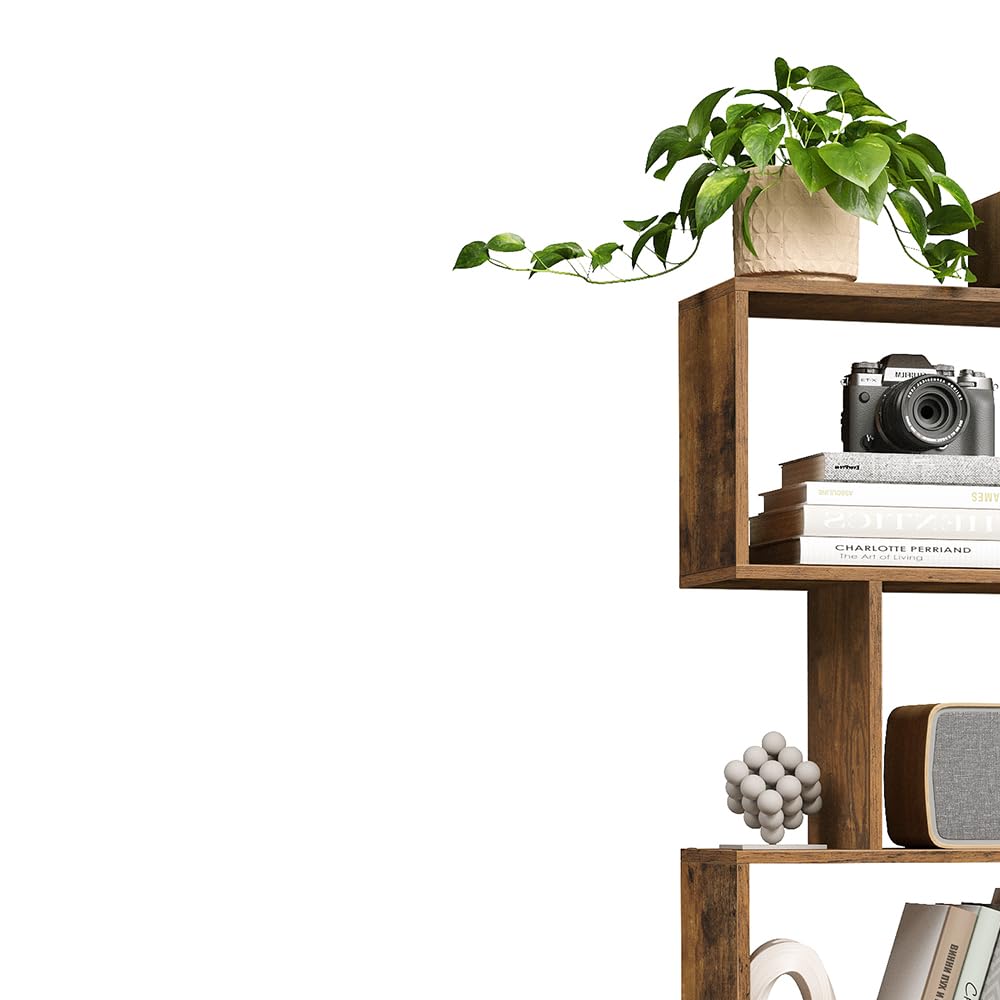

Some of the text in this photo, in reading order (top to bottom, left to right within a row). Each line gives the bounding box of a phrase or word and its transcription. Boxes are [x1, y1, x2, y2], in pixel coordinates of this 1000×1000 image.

[835, 544, 972, 554] CHARLOTTE PERRIAND
[943, 944, 959, 974] ВИННИ
[939, 974, 950, 991] ПУХ
[936, 990, 944, 998] И
